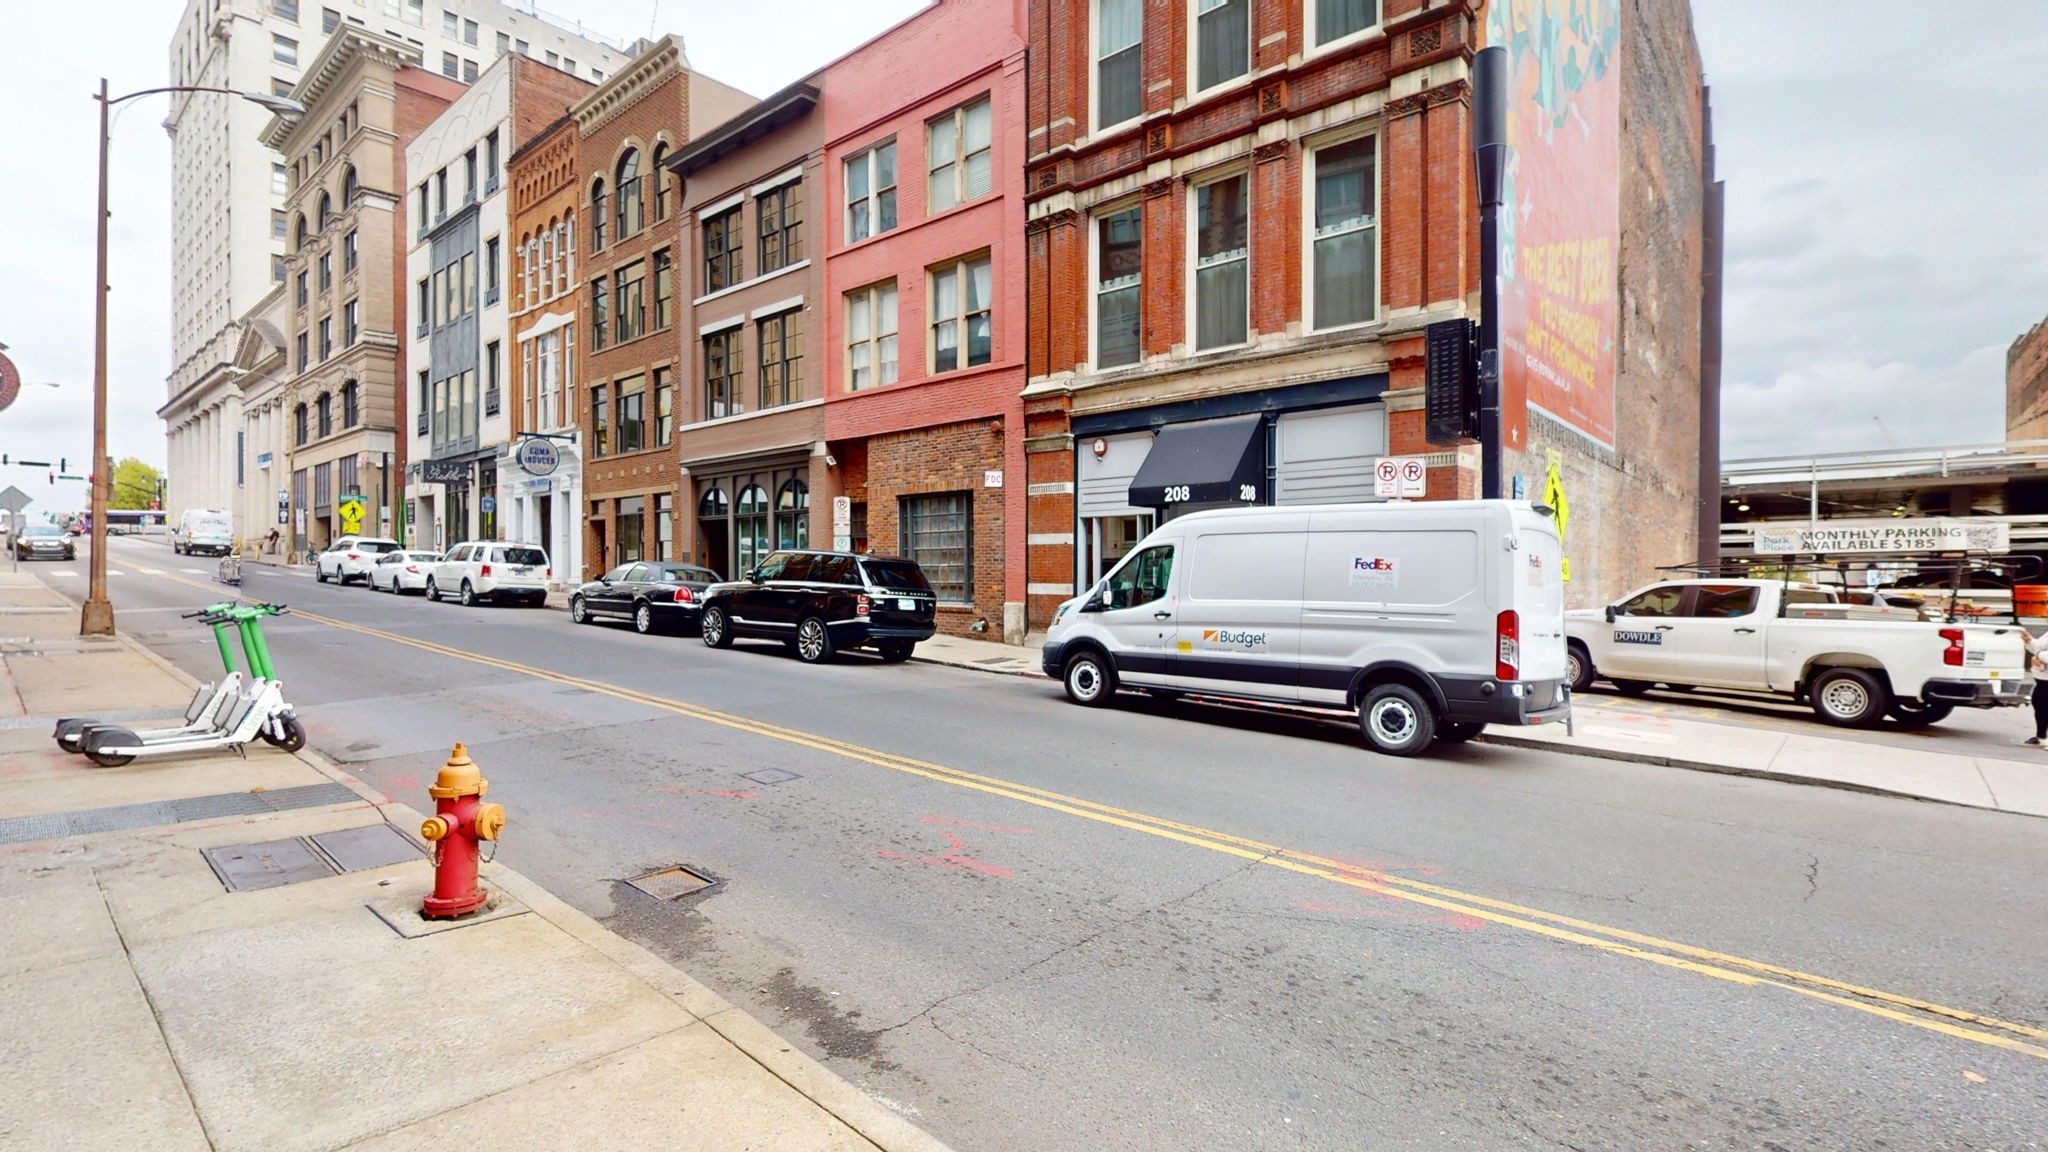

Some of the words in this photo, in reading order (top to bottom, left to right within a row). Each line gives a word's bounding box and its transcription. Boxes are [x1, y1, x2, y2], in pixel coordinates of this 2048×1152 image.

[1523, 245, 1545, 285] THE
[1548, 240, 1580, 301] BEST
[1581, 236, 1608, 305] BEER
[986, 475, 1001, 483] FDC
[1164, 485, 1190, 502] 208
[1240, 484, 1256, 501] 208
[1763, 536, 1790, 544] Park
[1800, 529, 1880, 540] MONTHLY
[1885, 527, 1961, 538] PARKING
[1801, 539, 1888, 550] AVAILABLE
[1894, 539, 1936, 549] $185
[1355, 557, 1393, 571] FedEx
[1220, 630, 1266, 648] Budget
[1615, 631, 1662, 643] DOWDLE
